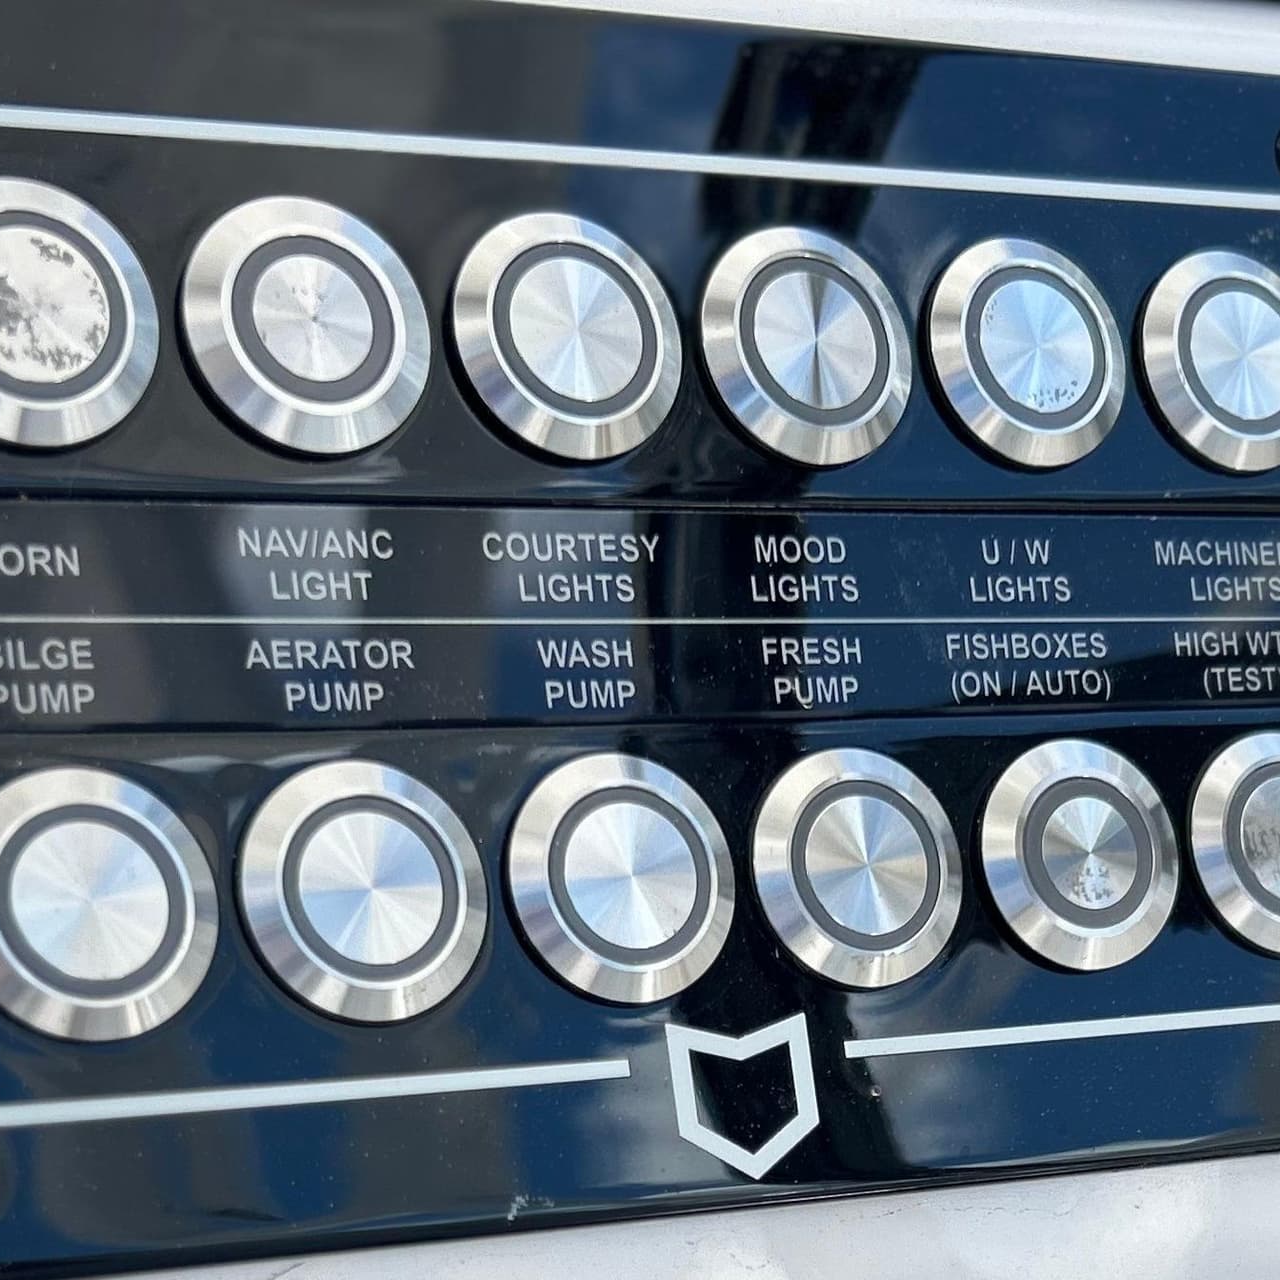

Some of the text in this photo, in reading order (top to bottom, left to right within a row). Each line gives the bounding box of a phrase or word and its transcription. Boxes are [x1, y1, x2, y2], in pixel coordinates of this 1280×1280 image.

[238, 528, 394, 559] NAV/ANC
[482, 532, 659, 564] COURTESY
[754, 537, 846, 565] MOOD
[269, 571, 373, 601] LIGHT
[518, 573, 635, 603] LIGHTS
[750, 575, 860, 603] LIGHTS
[969, 577, 1071, 603] LIGHTS
[245, 640, 415, 670] AERATOR
[536, 640, 633, 669] WASH
[762, 638, 862, 666] FRESH
[946, 633, 1107, 659] FISHBOXES
[1174, 631, 1239, 657] HIGH
[285, 682, 384, 712] PUMP
[544, 681, 636, 709] PUMP
[774, 677, 859, 708] PUMP
[951, 670, 1003, 704] (ON
[1024, 669, 1112, 701] AUTO)
